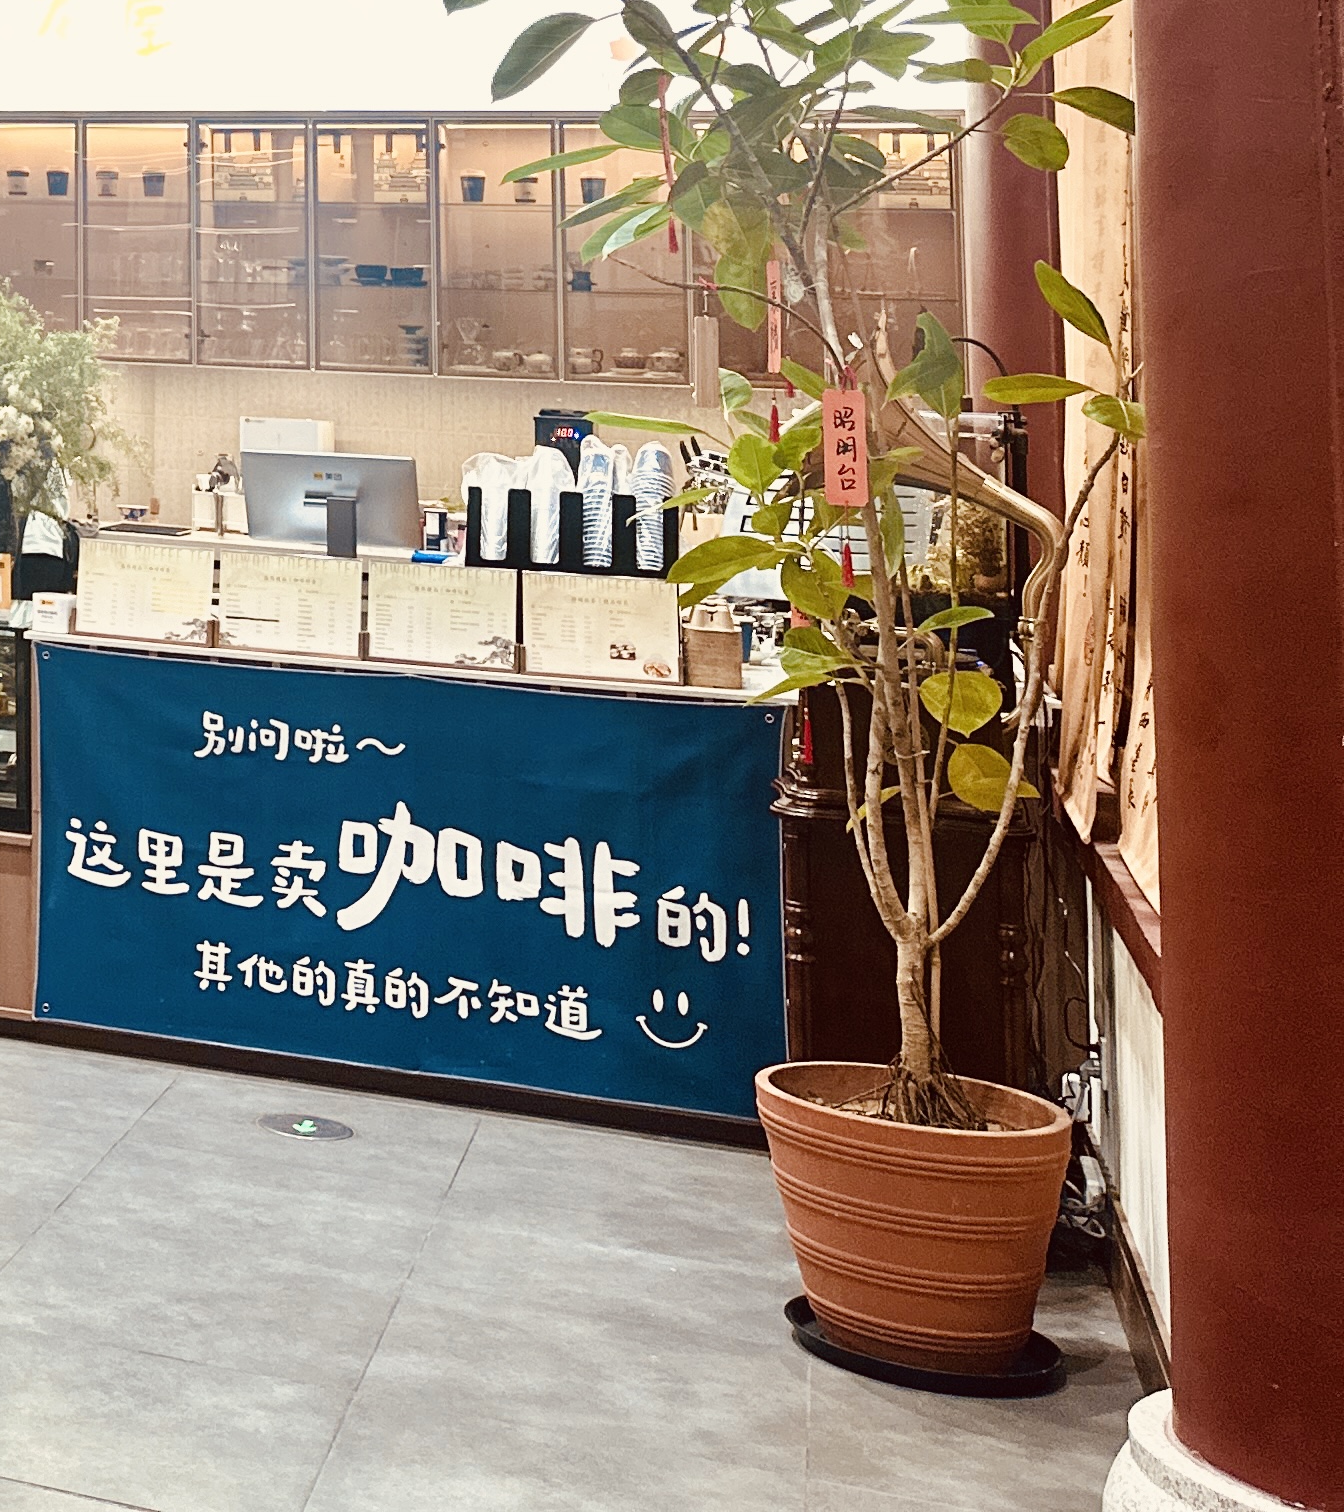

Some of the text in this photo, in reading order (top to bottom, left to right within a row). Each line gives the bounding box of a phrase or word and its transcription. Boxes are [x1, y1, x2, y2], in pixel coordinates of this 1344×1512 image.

[833, 405, 858, 491] 昭明台
[65, 800, 752, 964] 这里是卖咖啡的!
[193, 939, 603, 1042] 其他的真的不知道
